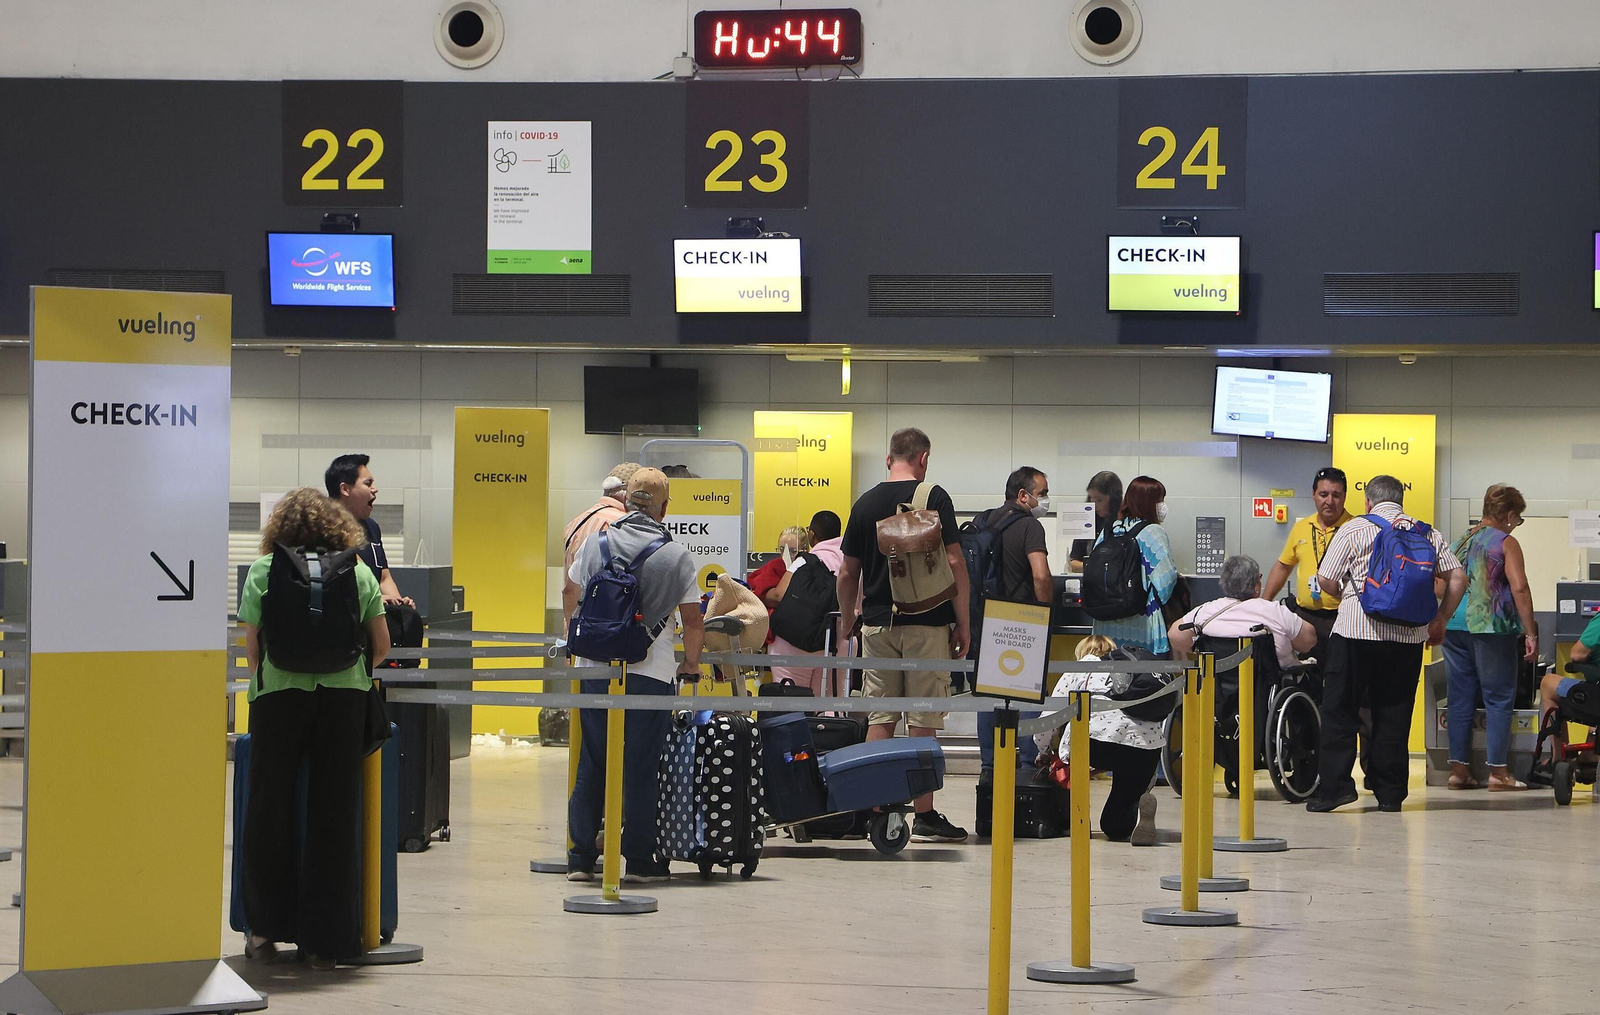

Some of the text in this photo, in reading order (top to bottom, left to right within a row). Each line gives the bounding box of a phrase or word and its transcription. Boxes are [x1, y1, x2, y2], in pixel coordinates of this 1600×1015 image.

[493, 130, 513, 140] info
[301, 128, 384, 190] 22
[704, 130, 788, 193] 23
[1136, 126, 1226, 190] 24
[683, 251, 768, 265] CHECK-IN
[1117, 248, 1206, 263] CHECK-IN
[334, 261, 372, 276] WFS
[292, 282, 372, 292] Worldwide Flight Services
[1173, 283, 1228, 302] vueling
[738, 285, 790, 303] vueling
[118, 312, 196, 343] vueling
[70, 401, 198, 427] CHECK-IN
[475, 429, 525, 448] vueling
[1355, 437, 1409, 455] vueling
[474, 473, 527, 483] CHECK-IN
[775, 478, 830, 487] CHECK-IN
[693, 492, 730, 504] vueling
[687, 543, 730, 555] luggage
[1018, 610, 1045, 620] vueling
[1003, 625, 1027, 634] MASKS
[992, 631, 1036, 642] MANDATORY
[1007, 641, 1032, 649] BOARD
[673, 700, 693, 708] vueling
[753, 700, 772, 708] vueling
